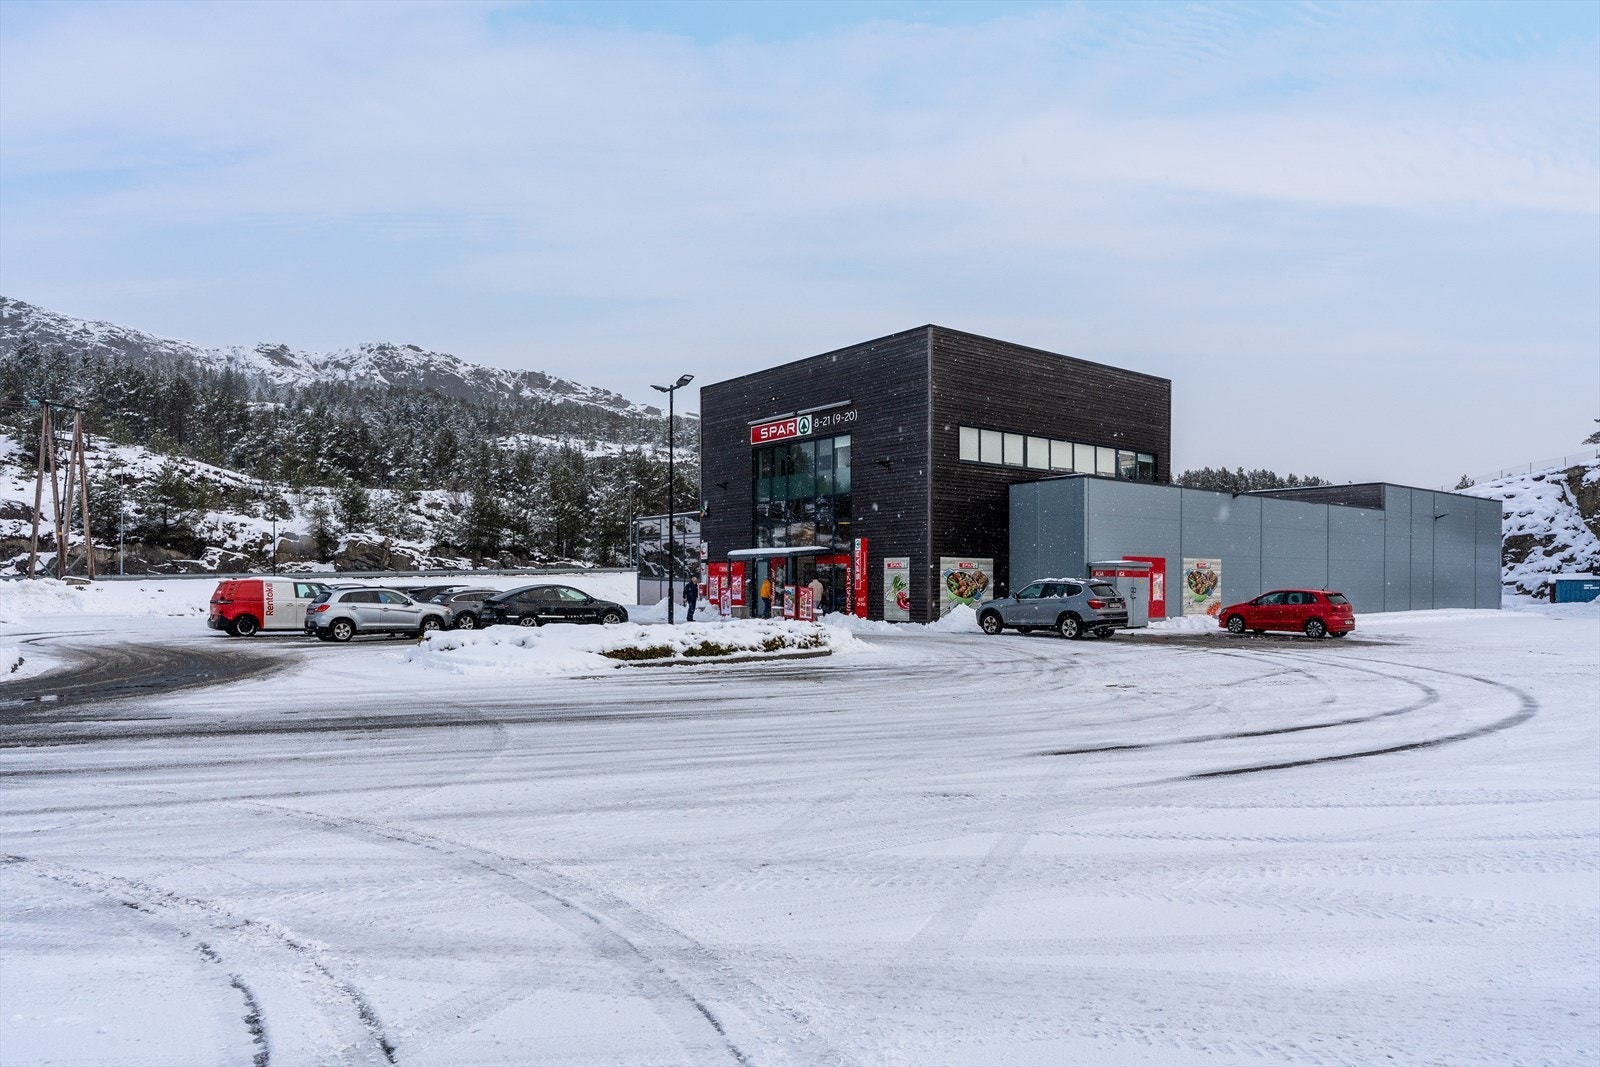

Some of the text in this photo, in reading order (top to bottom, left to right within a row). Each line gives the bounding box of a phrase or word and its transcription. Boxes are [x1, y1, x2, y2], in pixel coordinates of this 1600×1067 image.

[814, 409, 858, 428] 8-21 (9-20)
[760, 422, 796, 439] SPAR
